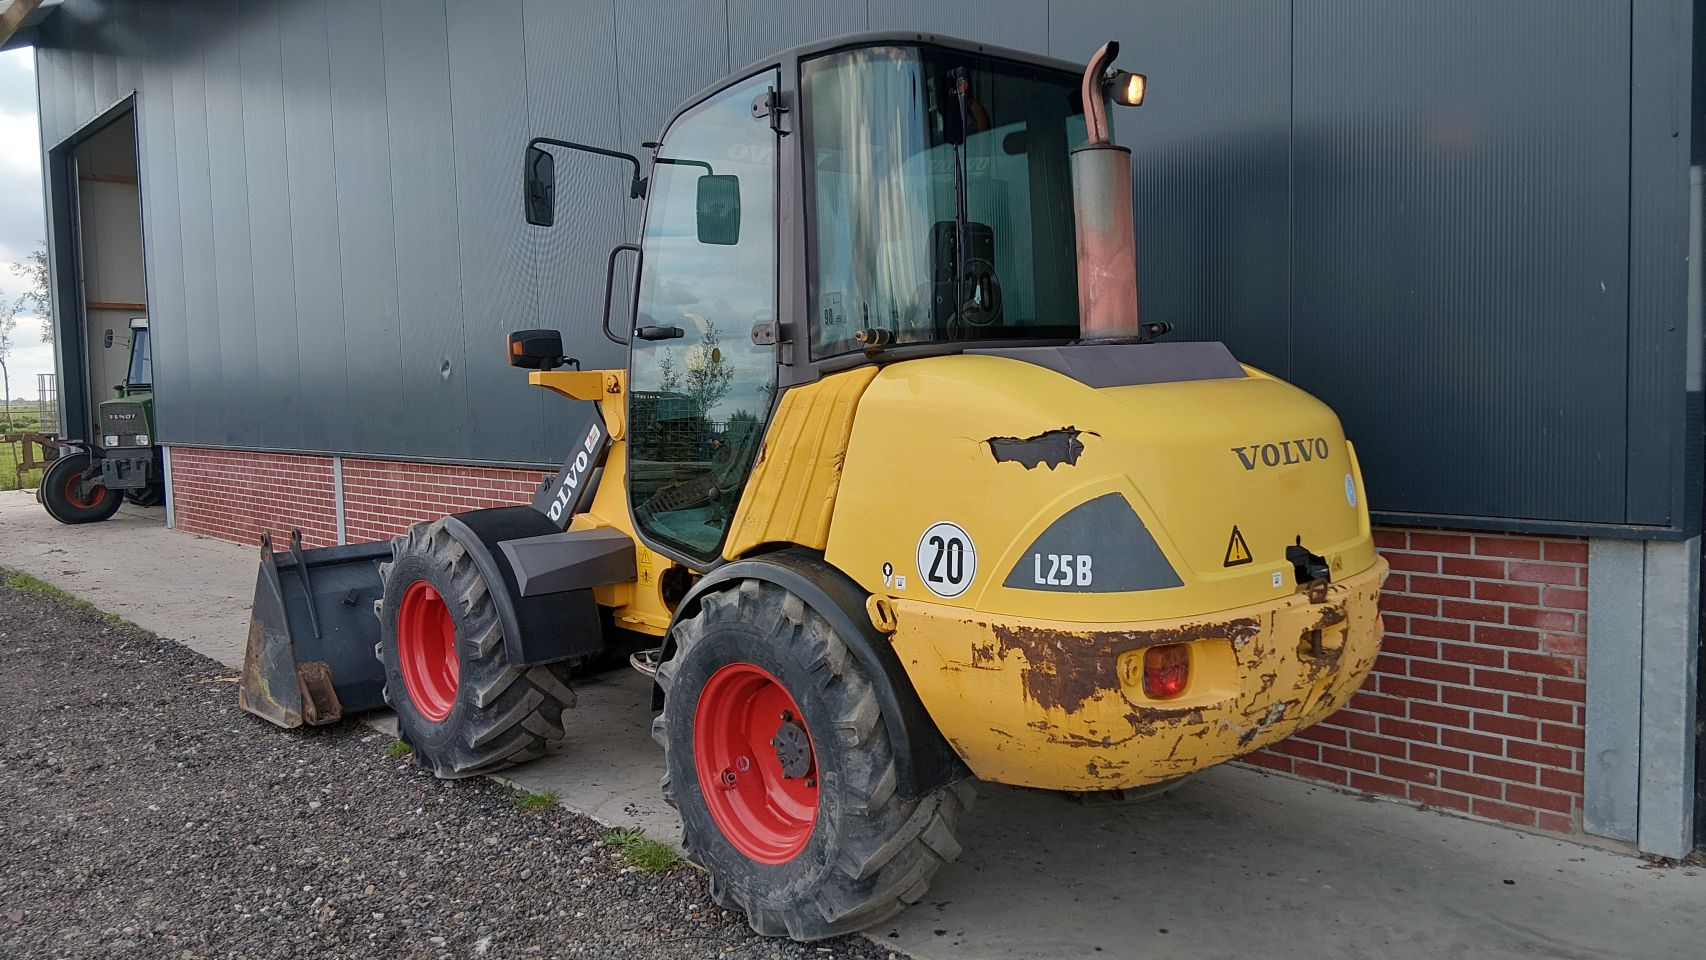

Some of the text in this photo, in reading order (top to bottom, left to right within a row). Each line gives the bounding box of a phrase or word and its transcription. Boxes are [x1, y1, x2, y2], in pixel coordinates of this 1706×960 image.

[1231, 437, 1329, 471] VOLVO
[547, 450, 588, 521] OLVO
[928, 535, 964, 585] 20
[1034, 553, 1093, 586] L25B
